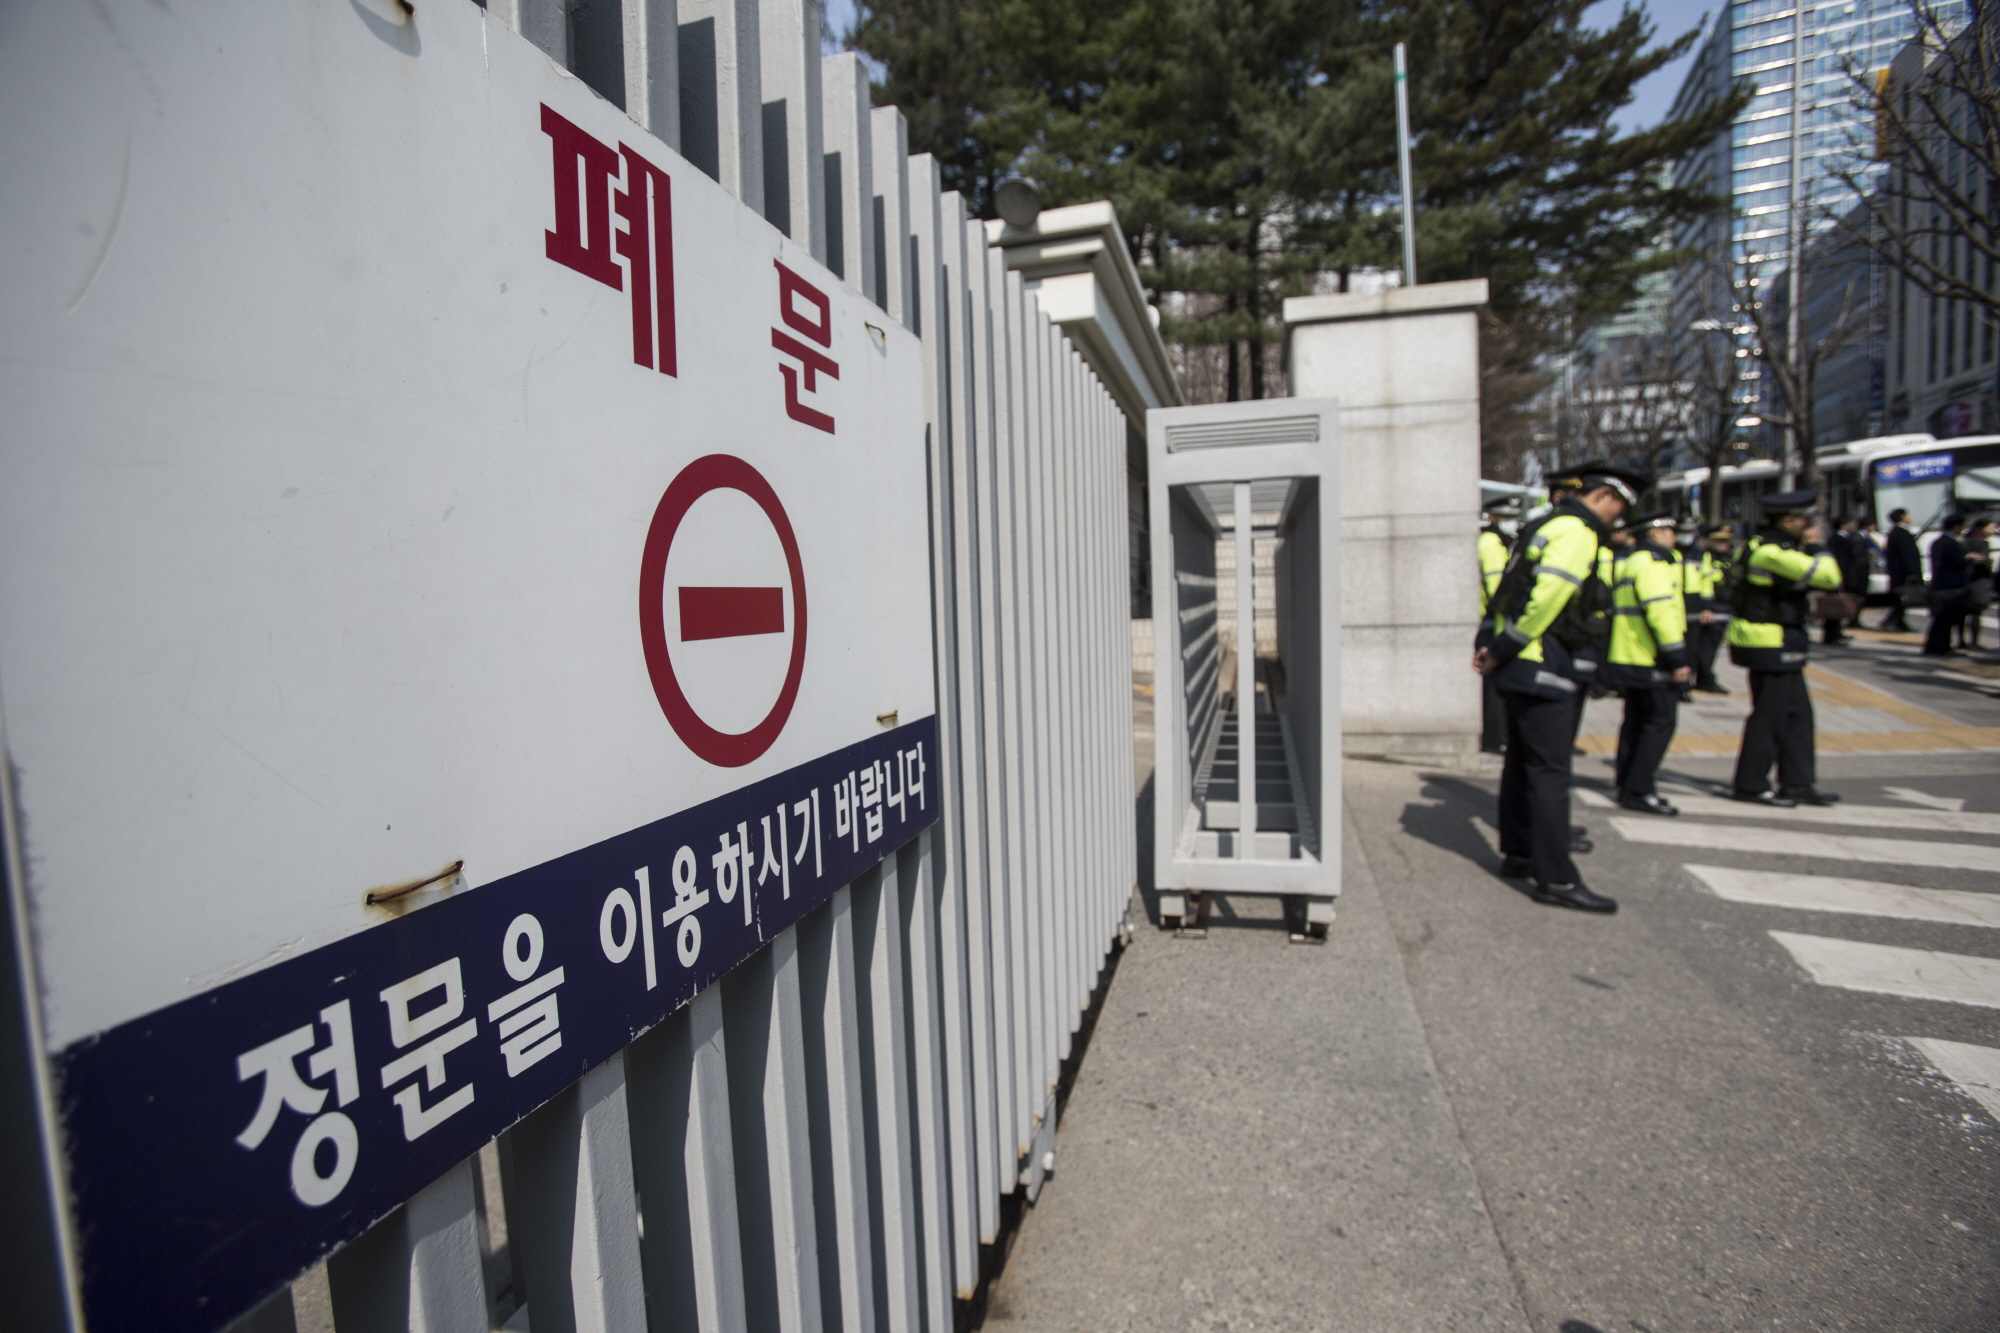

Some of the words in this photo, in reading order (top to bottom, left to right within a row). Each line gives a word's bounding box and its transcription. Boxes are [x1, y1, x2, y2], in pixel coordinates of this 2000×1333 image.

[235, 913, 565, 1206] 정문을
[600, 787, 823, 991] 이용하시기
[833, 741, 926, 853] 바랍니다
